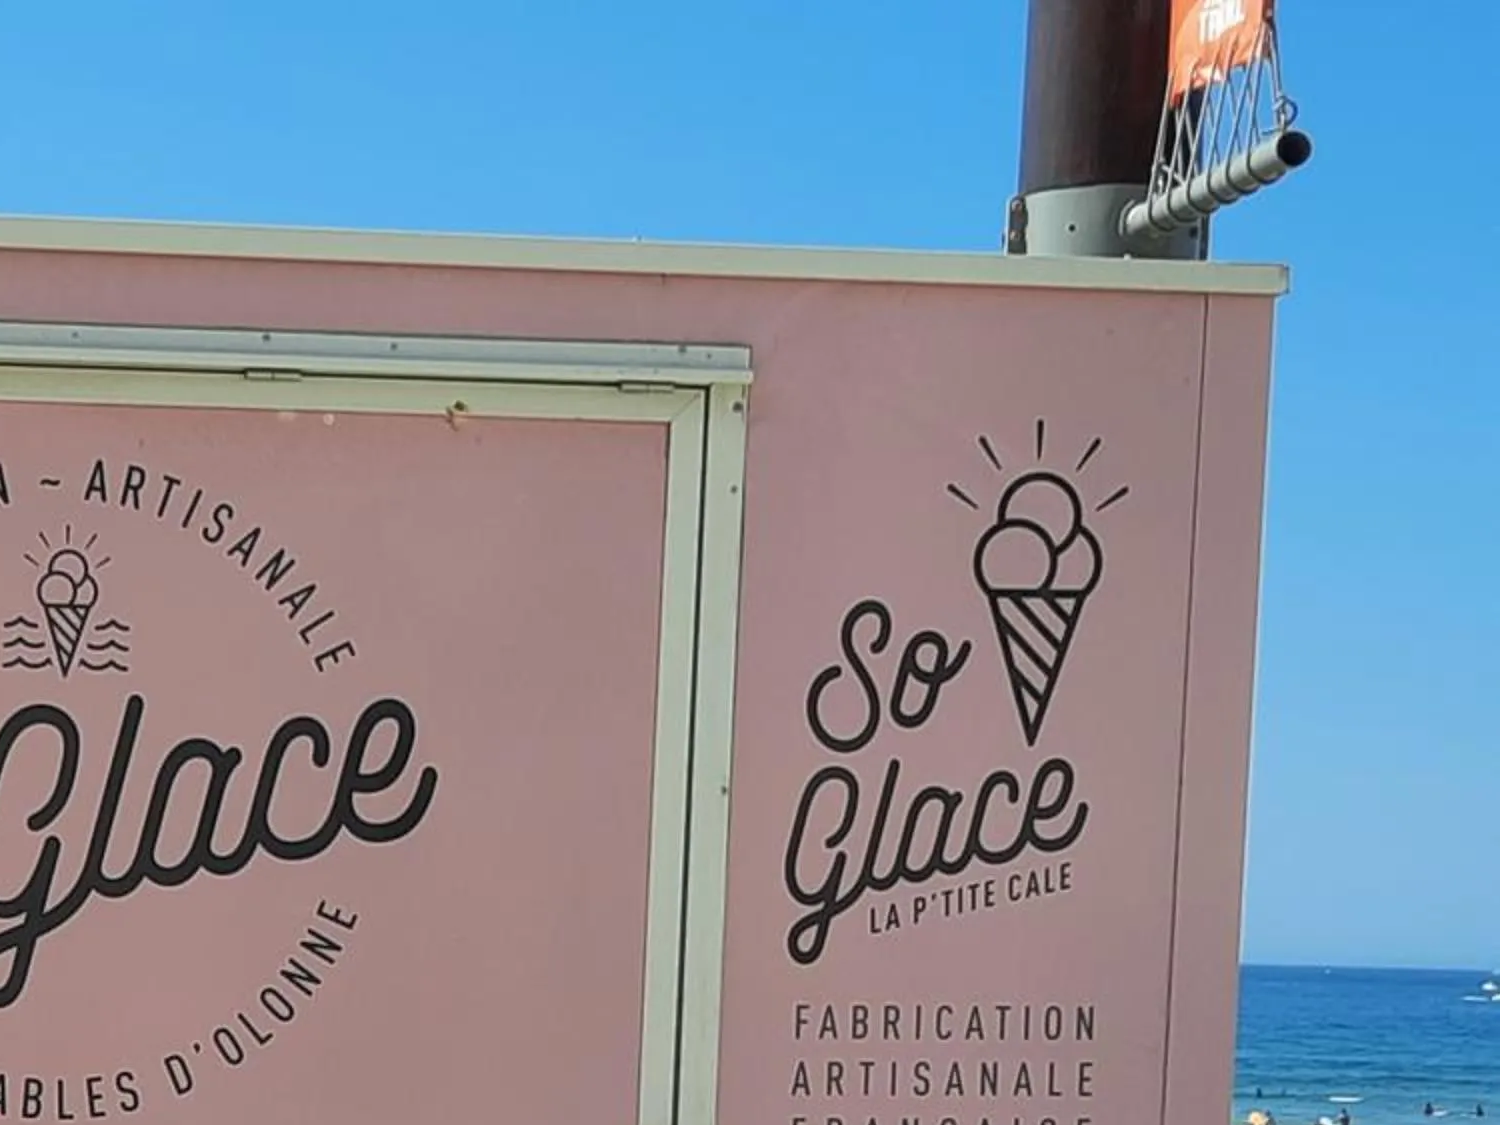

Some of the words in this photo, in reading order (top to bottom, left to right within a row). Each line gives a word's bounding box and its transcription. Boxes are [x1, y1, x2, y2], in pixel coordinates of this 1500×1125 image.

[83, 459, 356, 673] ARTISANALE
[806, 599, 972, 754] So
[784, 757, 1089, 965] Glace
[870, 903, 901, 934] LA
[913, 879, 995, 925] P'TITE
[1008, 862, 1071, 902] CALE
[163, 899, 358, 1096] D'OLONNE
[795, 1004, 1094, 1041] FABRICATION
[791, 1061, 1093, 1097] ARTISANALE
